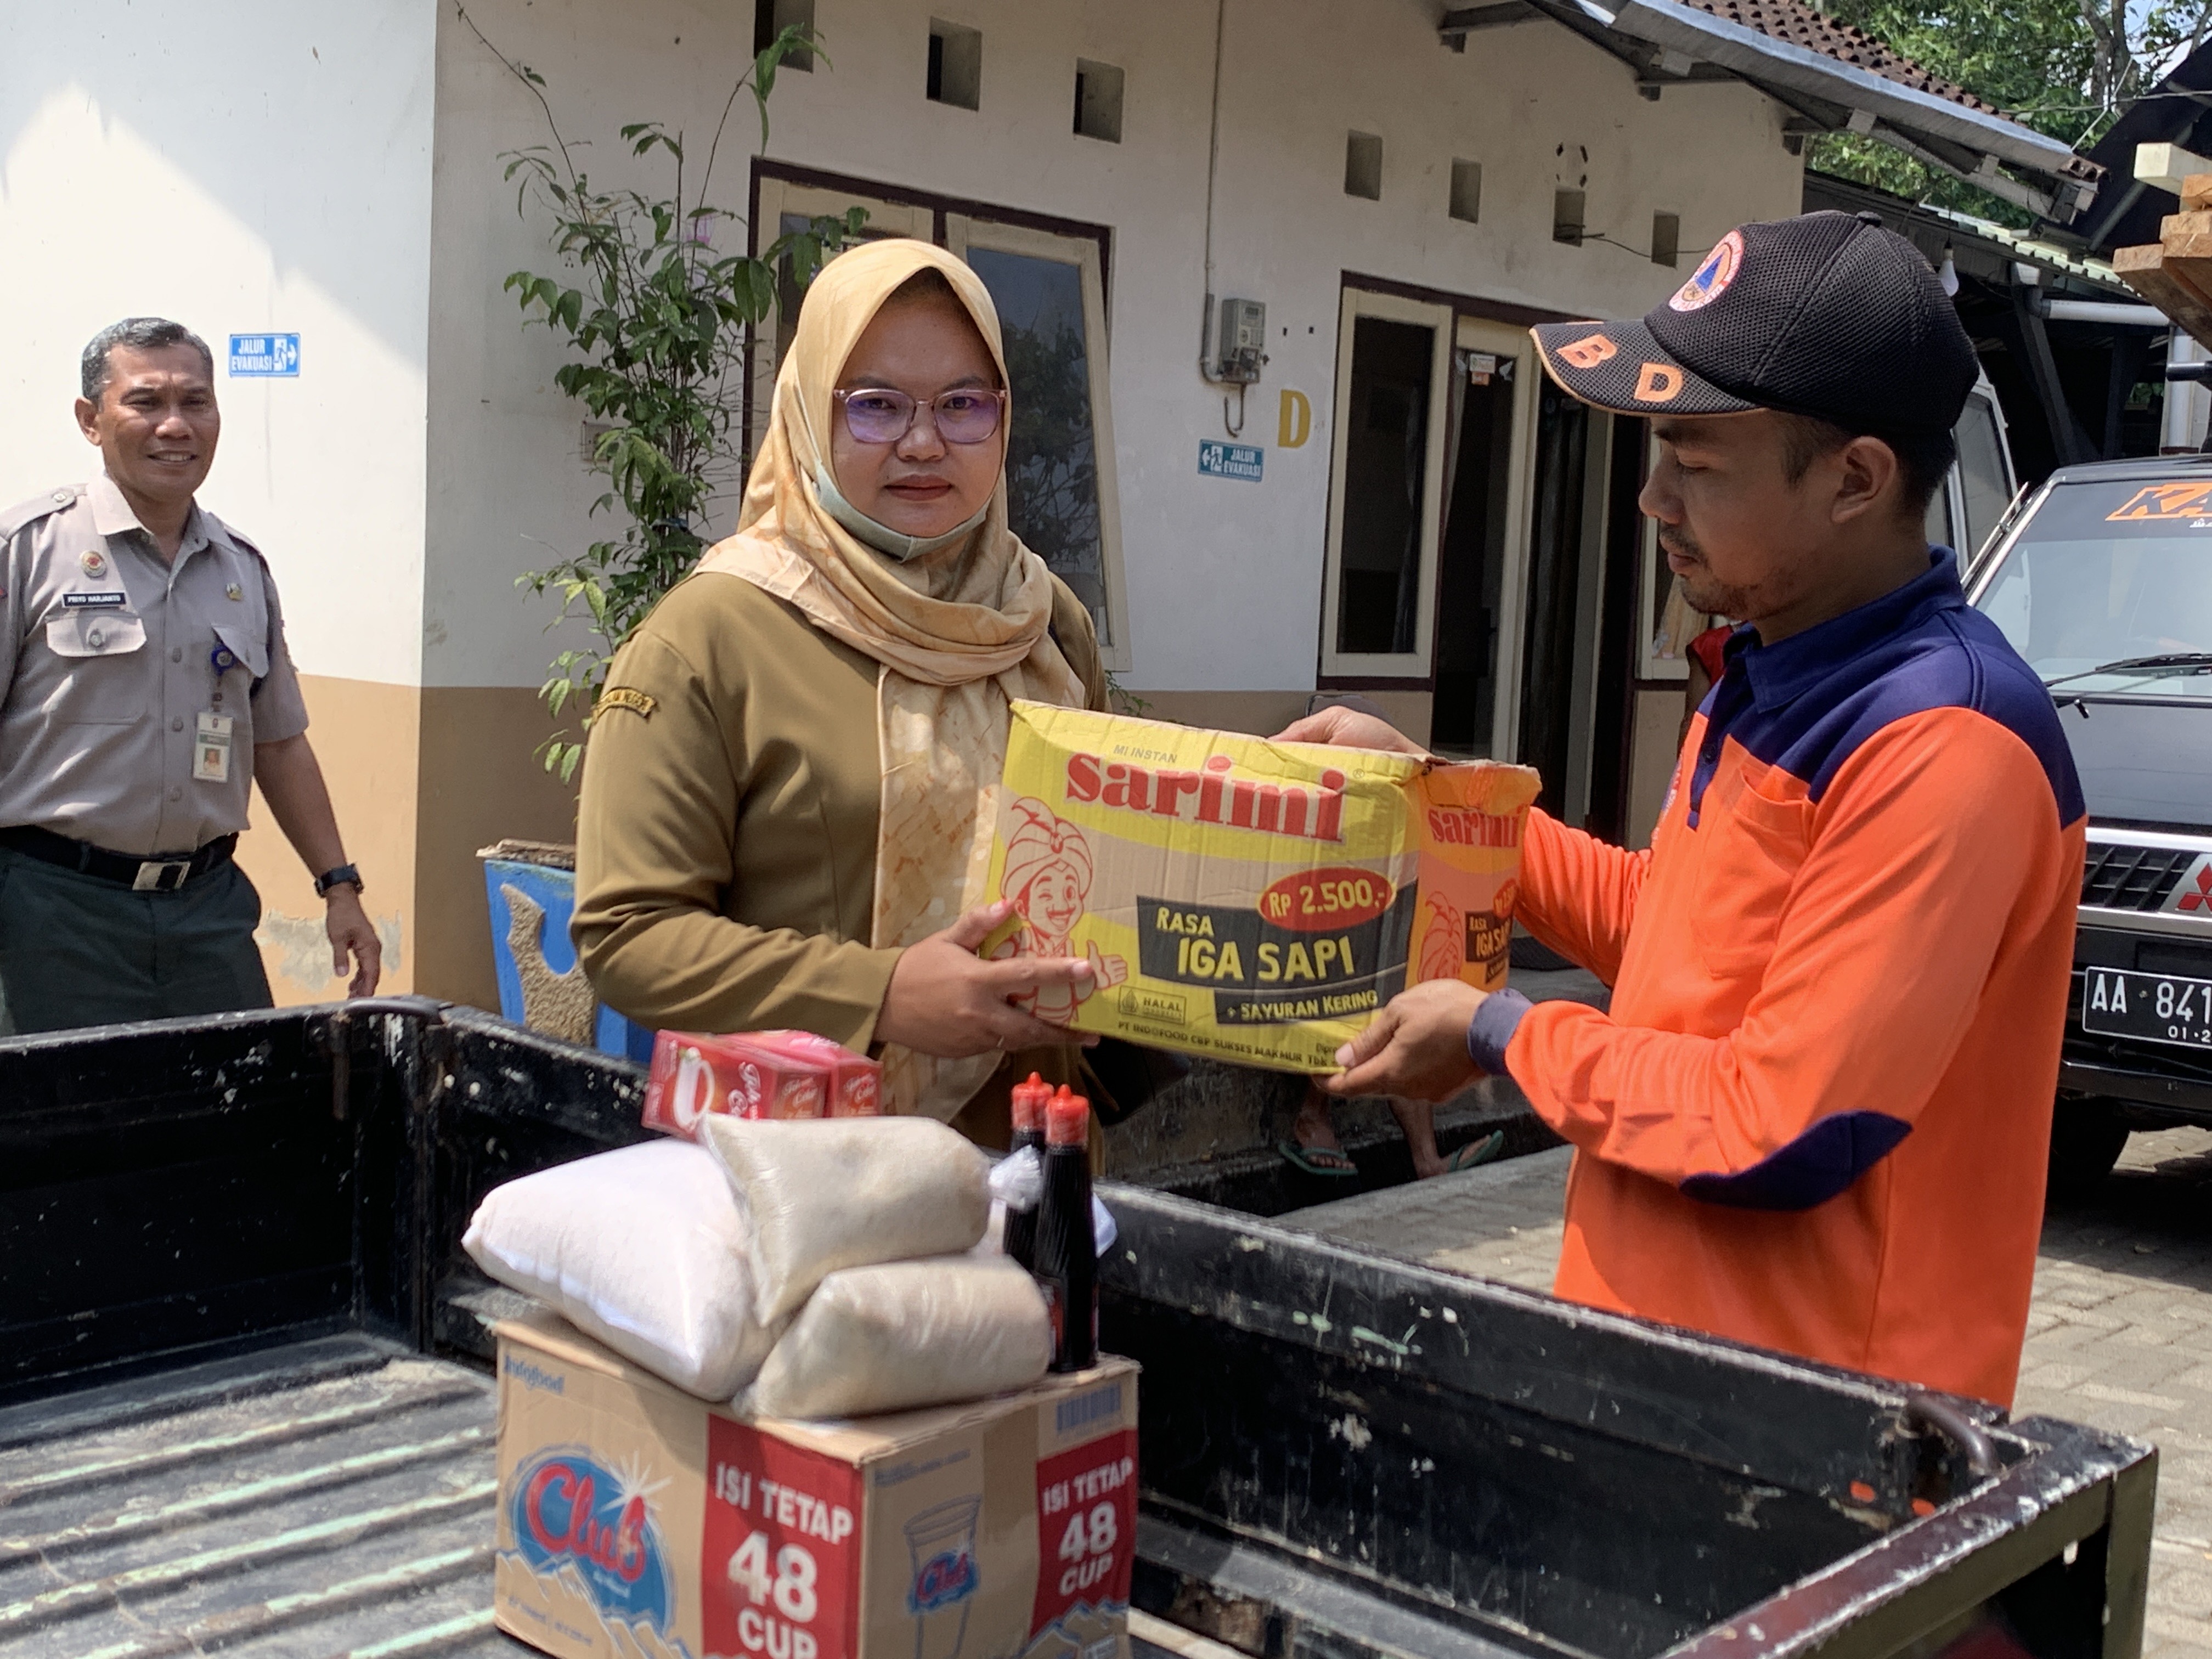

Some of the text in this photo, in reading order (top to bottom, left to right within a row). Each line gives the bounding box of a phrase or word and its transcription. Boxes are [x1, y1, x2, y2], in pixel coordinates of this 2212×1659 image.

[232, 355, 273, 371] EVAKUASI
[238, 338, 266, 355] JALUR
[1277, 388, 1312, 448] D
[1223, 460, 1262, 477] EVAKUASI
[1231, 448, 1256, 464] JALUR
[1113, 744, 1178, 764] MI INSTAN
[1299, 878, 1385, 915] 2.500,-
[1156, 906, 1215, 938] RASA
[1178, 935, 1355, 982] IGA SAPI
[1143, 997, 1181, 1012] HALAL
[1240, 999, 1319, 1021] SAYURAN
[1322, 989, 1379, 1014] KERING
[2091, 973, 2212, 1024] AA 841
[1118, 1021, 1130, 1031] PT
[1133, 1024, 1189, 1042] INDOFOOD
[1190, 1035, 1211, 1046] CBP
[1214, 1039, 1252, 1054] SUKSES
[1254, 1045, 1303, 1062] MAKMUR
[714, 1462, 854, 1545] ISI TETAP
[1043, 1456, 1134, 1516] ISI TETAP
[525, 1463, 647, 1582] Club
[1057, 1501, 1118, 1564] 48
[727, 1530, 819, 1623] 48
[1059, 1551, 1114, 1596] CUP
[737, 1608, 819, 1659] CUP
